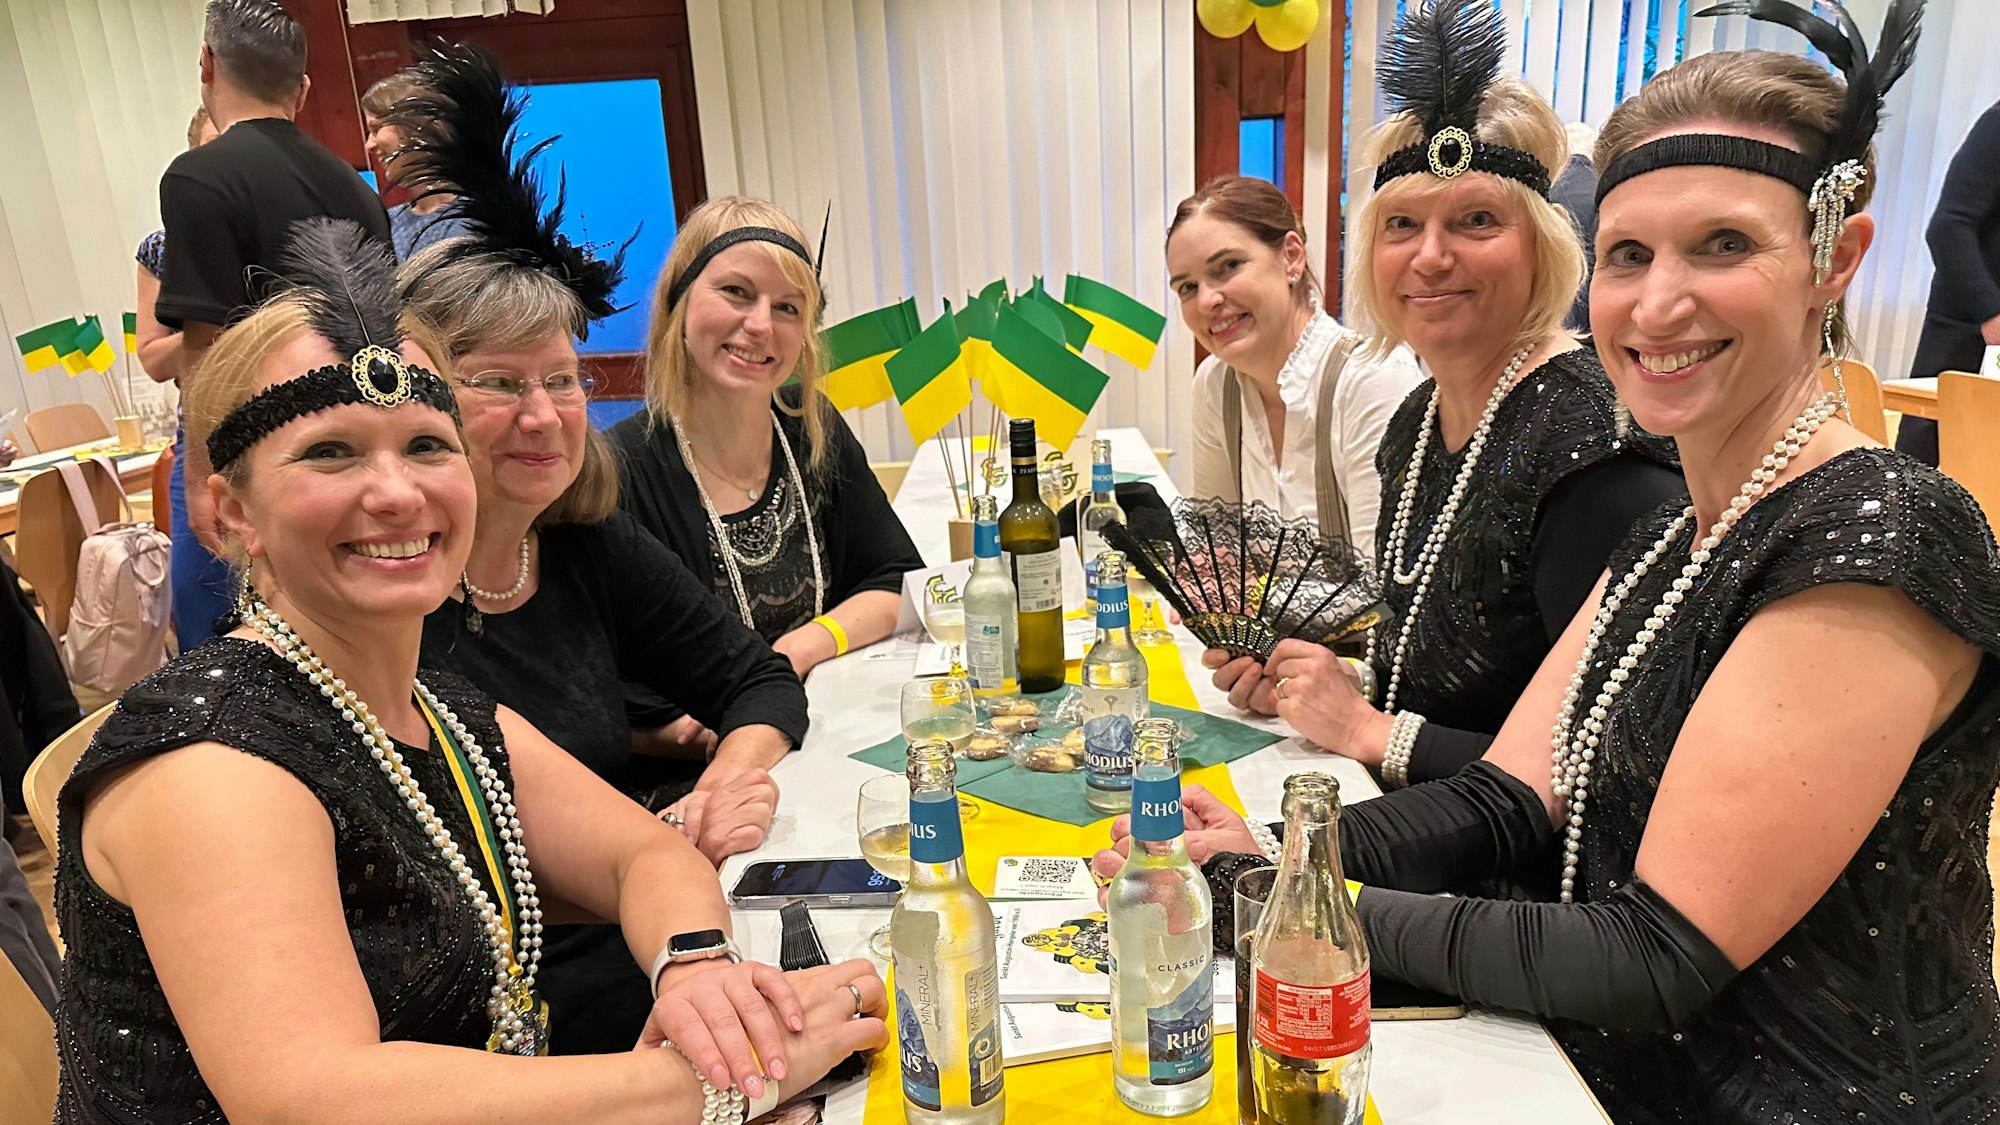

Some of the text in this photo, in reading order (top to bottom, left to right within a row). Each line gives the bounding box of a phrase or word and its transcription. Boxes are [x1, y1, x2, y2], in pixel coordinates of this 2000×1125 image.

[1096, 599, 1129, 614] ODIUS
[1085, 752, 1136, 769] HODIUS
[909, 822, 937, 839] IUS
[1158, 955, 1206, 972] CLASSIC
[970, 976, 981, 1032] MINERAL+
[901, 1045, 922, 1073] US
